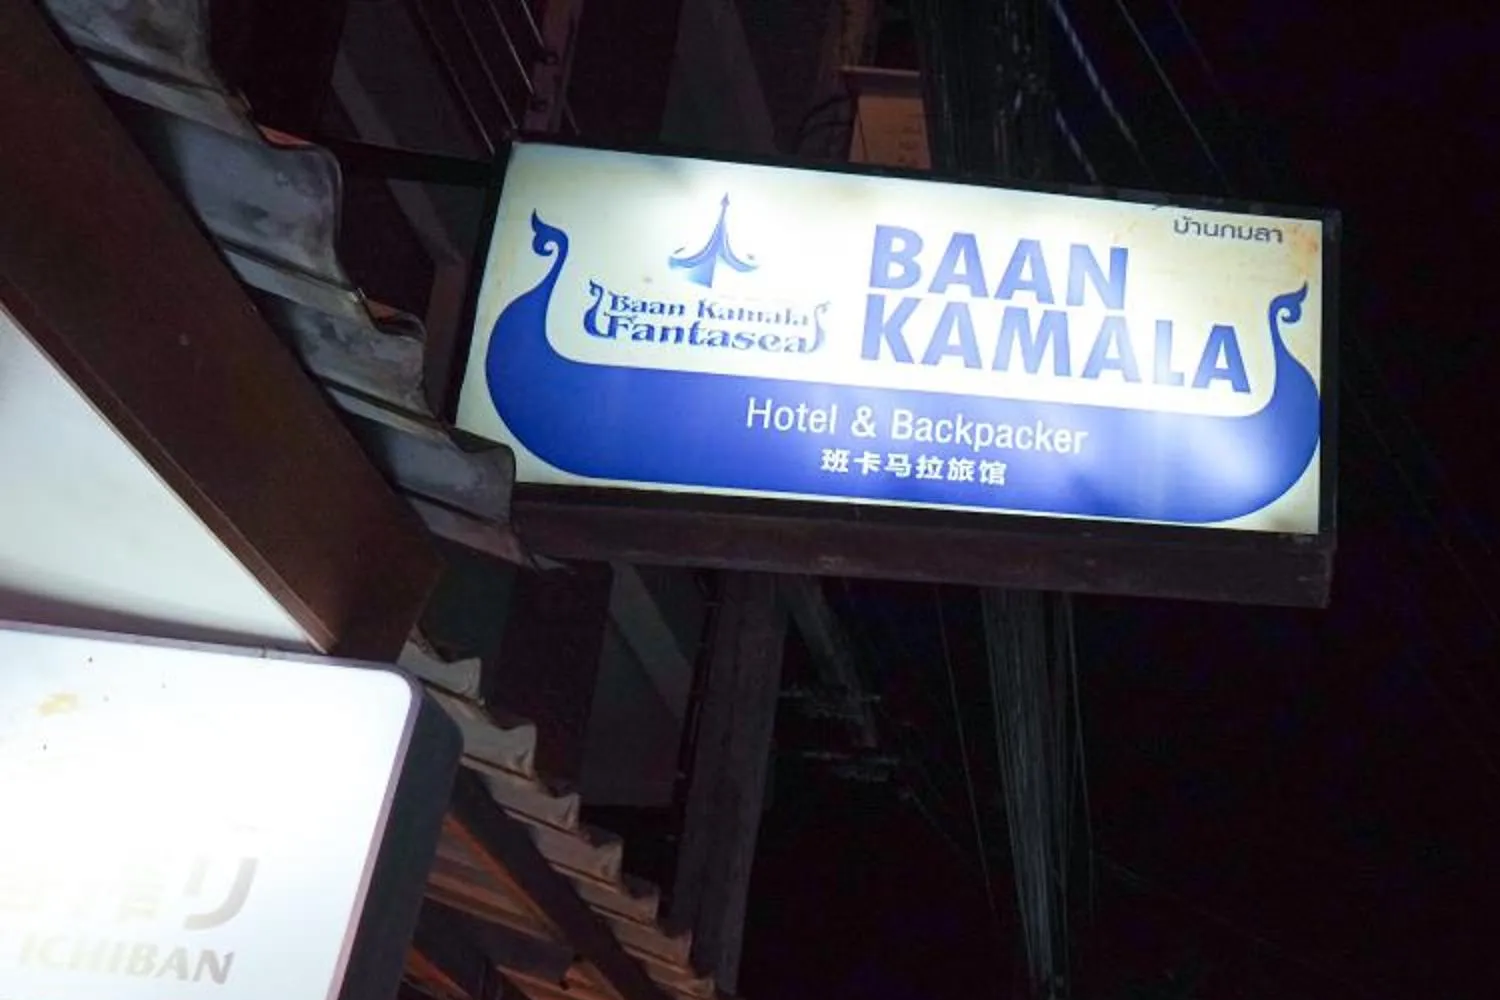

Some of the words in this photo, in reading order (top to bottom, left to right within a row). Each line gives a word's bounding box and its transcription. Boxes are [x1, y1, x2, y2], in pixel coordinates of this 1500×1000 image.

[868, 224, 1130, 310] BAAN
[608, 291, 685, 317] Baan
[604, 312, 812, 354] Fantasea
[859, 296, 1252, 395] KAMALA
[746, 397, 838, 434] Hotel
[851, 405, 877, 438] &
[892, 408, 1088, 455] Backpacker
[819, 447, 1008, 486] 班卡马拉旅馆
[18, 930, 236, 986] ICHIBAN
